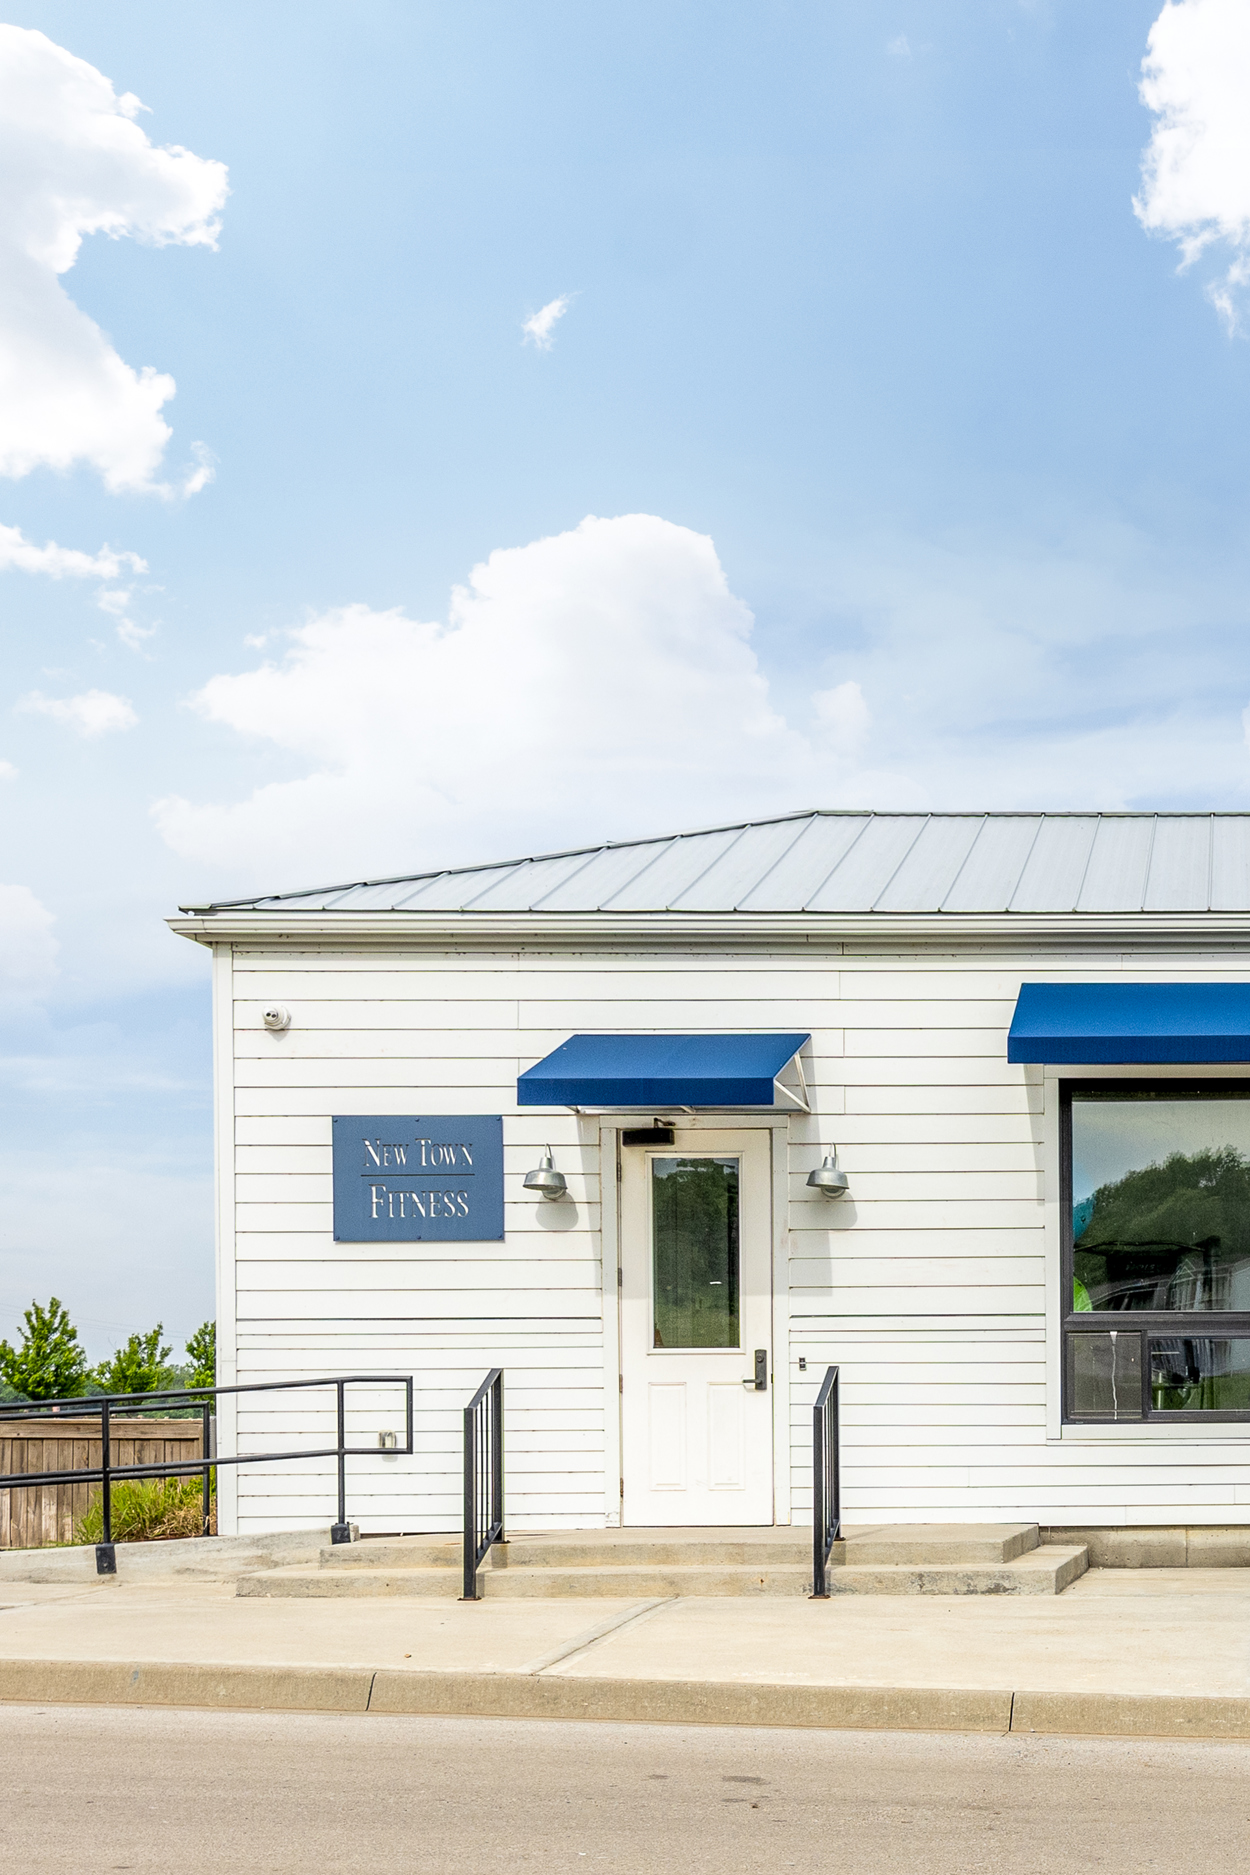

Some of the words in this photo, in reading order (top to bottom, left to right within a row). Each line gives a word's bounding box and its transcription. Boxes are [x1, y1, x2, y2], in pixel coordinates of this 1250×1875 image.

[361, 1138, 409, 1167] NEW
[415, 1138, 473, 1166] TOWN
[368, 1183, 469, 1218] FITNESS
